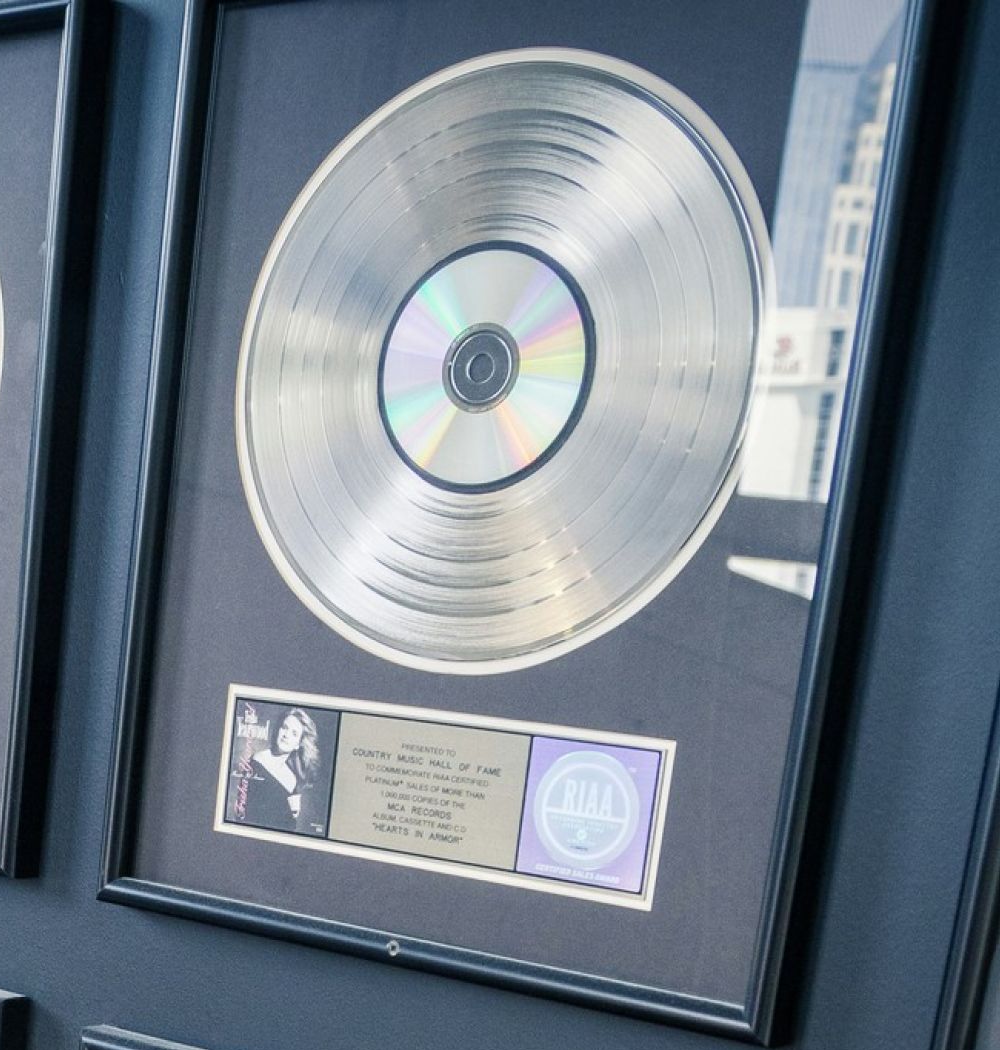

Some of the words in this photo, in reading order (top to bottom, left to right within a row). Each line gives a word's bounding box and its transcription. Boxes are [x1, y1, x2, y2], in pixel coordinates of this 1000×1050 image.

[401, 742, 444, 755] PRESENTED
[445, 748, 456, 756] TO
[352, 747, 391, 760] COUNTRY
[396, 753, 424, 765] MUSIC
[429, 758, 453, 769] HALL
[458, 762, 470, 771] OF
[476, 764, 502, 776] FAME
[364, 762, 374, 770] TO
[406, 781, 428, 790] SALES
[430, 784, 439, 792] OF
[441, 786, 462, 795] MORE
[465, 790, 486, 799] THAN
[563, 778, 613, 817] RIAA
[412, 794, 438, 805] COPIES
[440, 798, 449, 806] OF
[452, 800, 465, 809] THE
[386, 802, 405, 812] MCA
[410, 805, 452, 820] RECORDS
[436, 821, 452, 830] AND
[414, 829, 423, 838] IN
